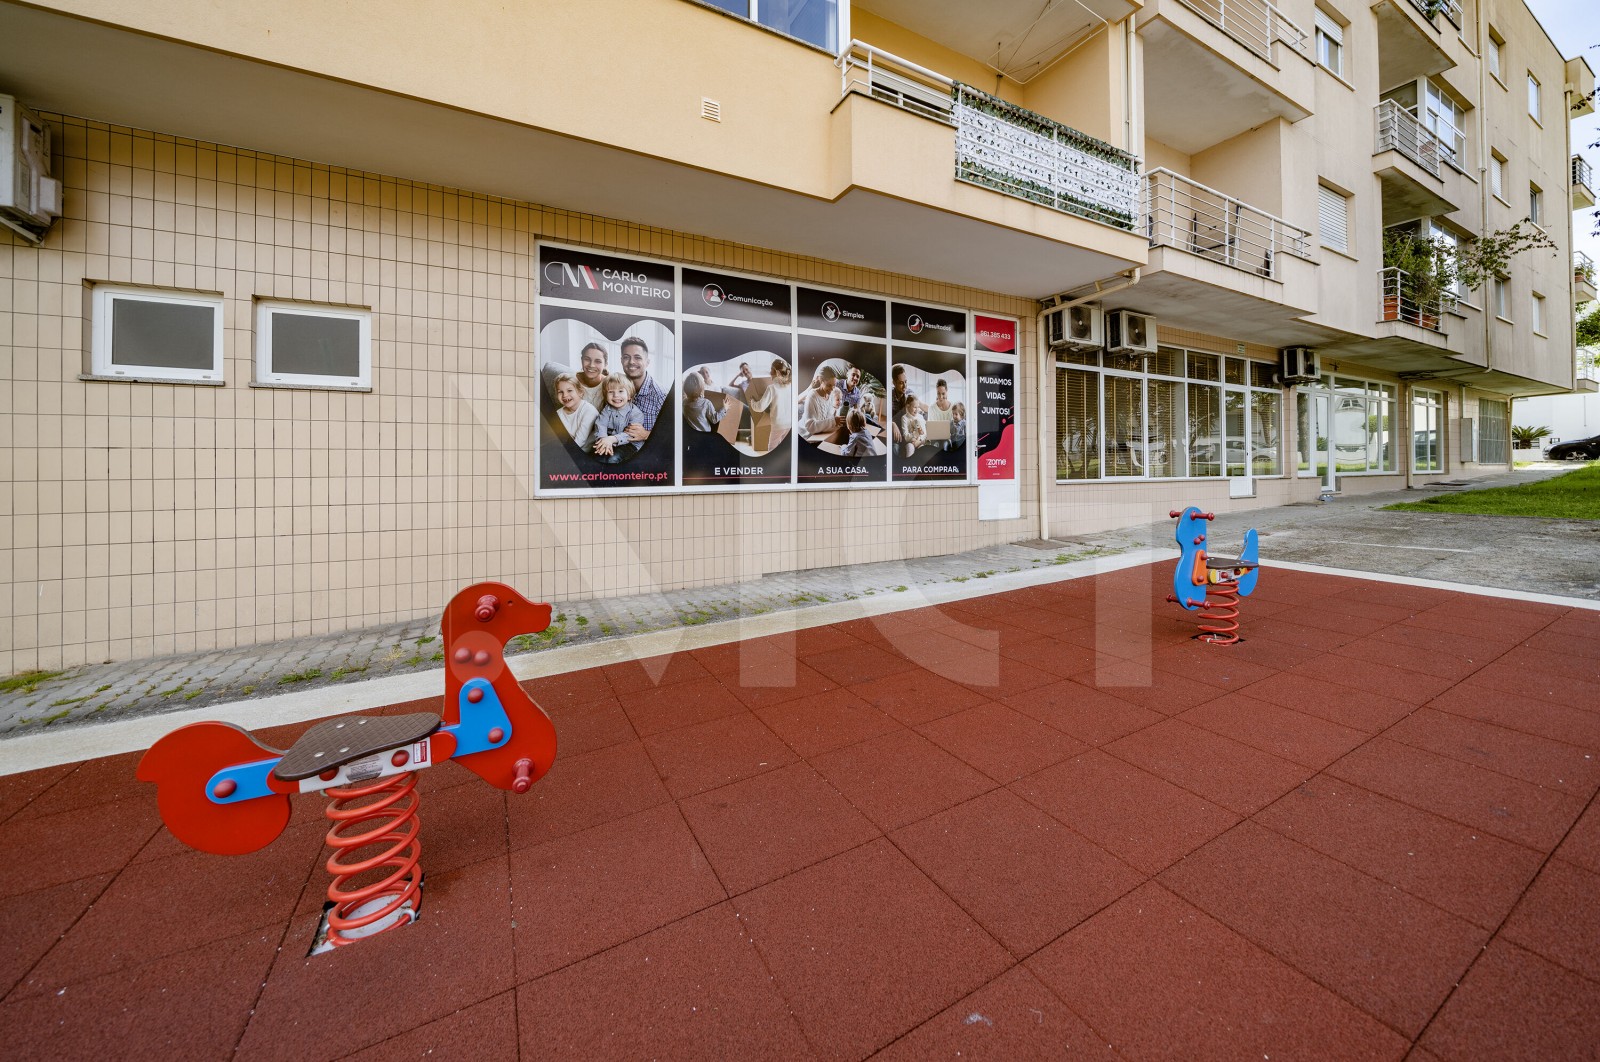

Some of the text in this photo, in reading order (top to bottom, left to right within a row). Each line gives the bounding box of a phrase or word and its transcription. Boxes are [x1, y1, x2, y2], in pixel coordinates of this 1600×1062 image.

[602, 268, 648, 284] CARLO
[602, 281, 671, 299] MONTEIRO
[727, 293, 774, 307] Comunicação
[842, 310, 865, 320] Simples
[924, 322, 951, 331] Resultados
[979, 376, 1012, 386] MUDAMOS
[985, 391, 1006, 400] VIDAS
[981, 406, 1010, 416] JUNTOS!
[714, 467, 763, 476] E VENDER
[818, 466, 869, 475] A SUA CASA.
[549, 470, 668, 482] www.carlomonteiro.pt
